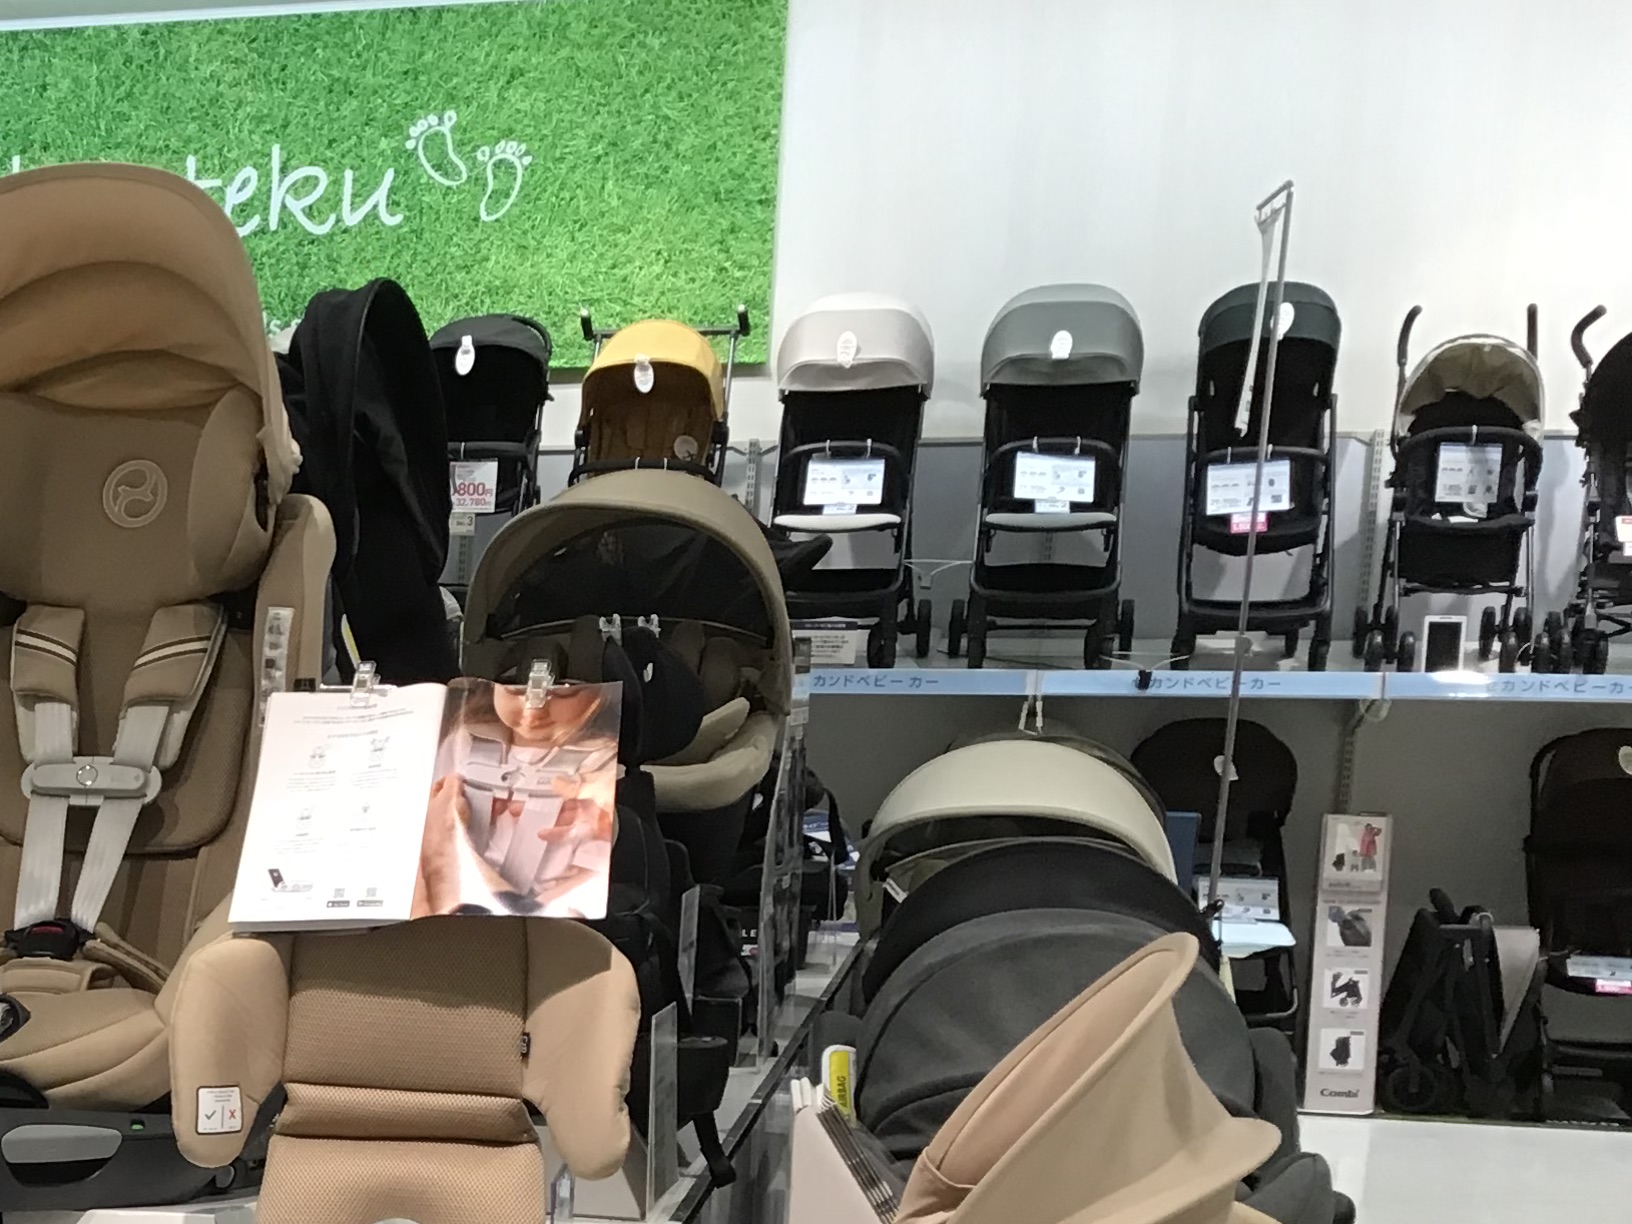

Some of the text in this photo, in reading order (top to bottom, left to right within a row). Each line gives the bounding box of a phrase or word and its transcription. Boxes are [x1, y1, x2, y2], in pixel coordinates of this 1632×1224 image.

[1484, 678, 1631, 694] セカンドベビーカ
